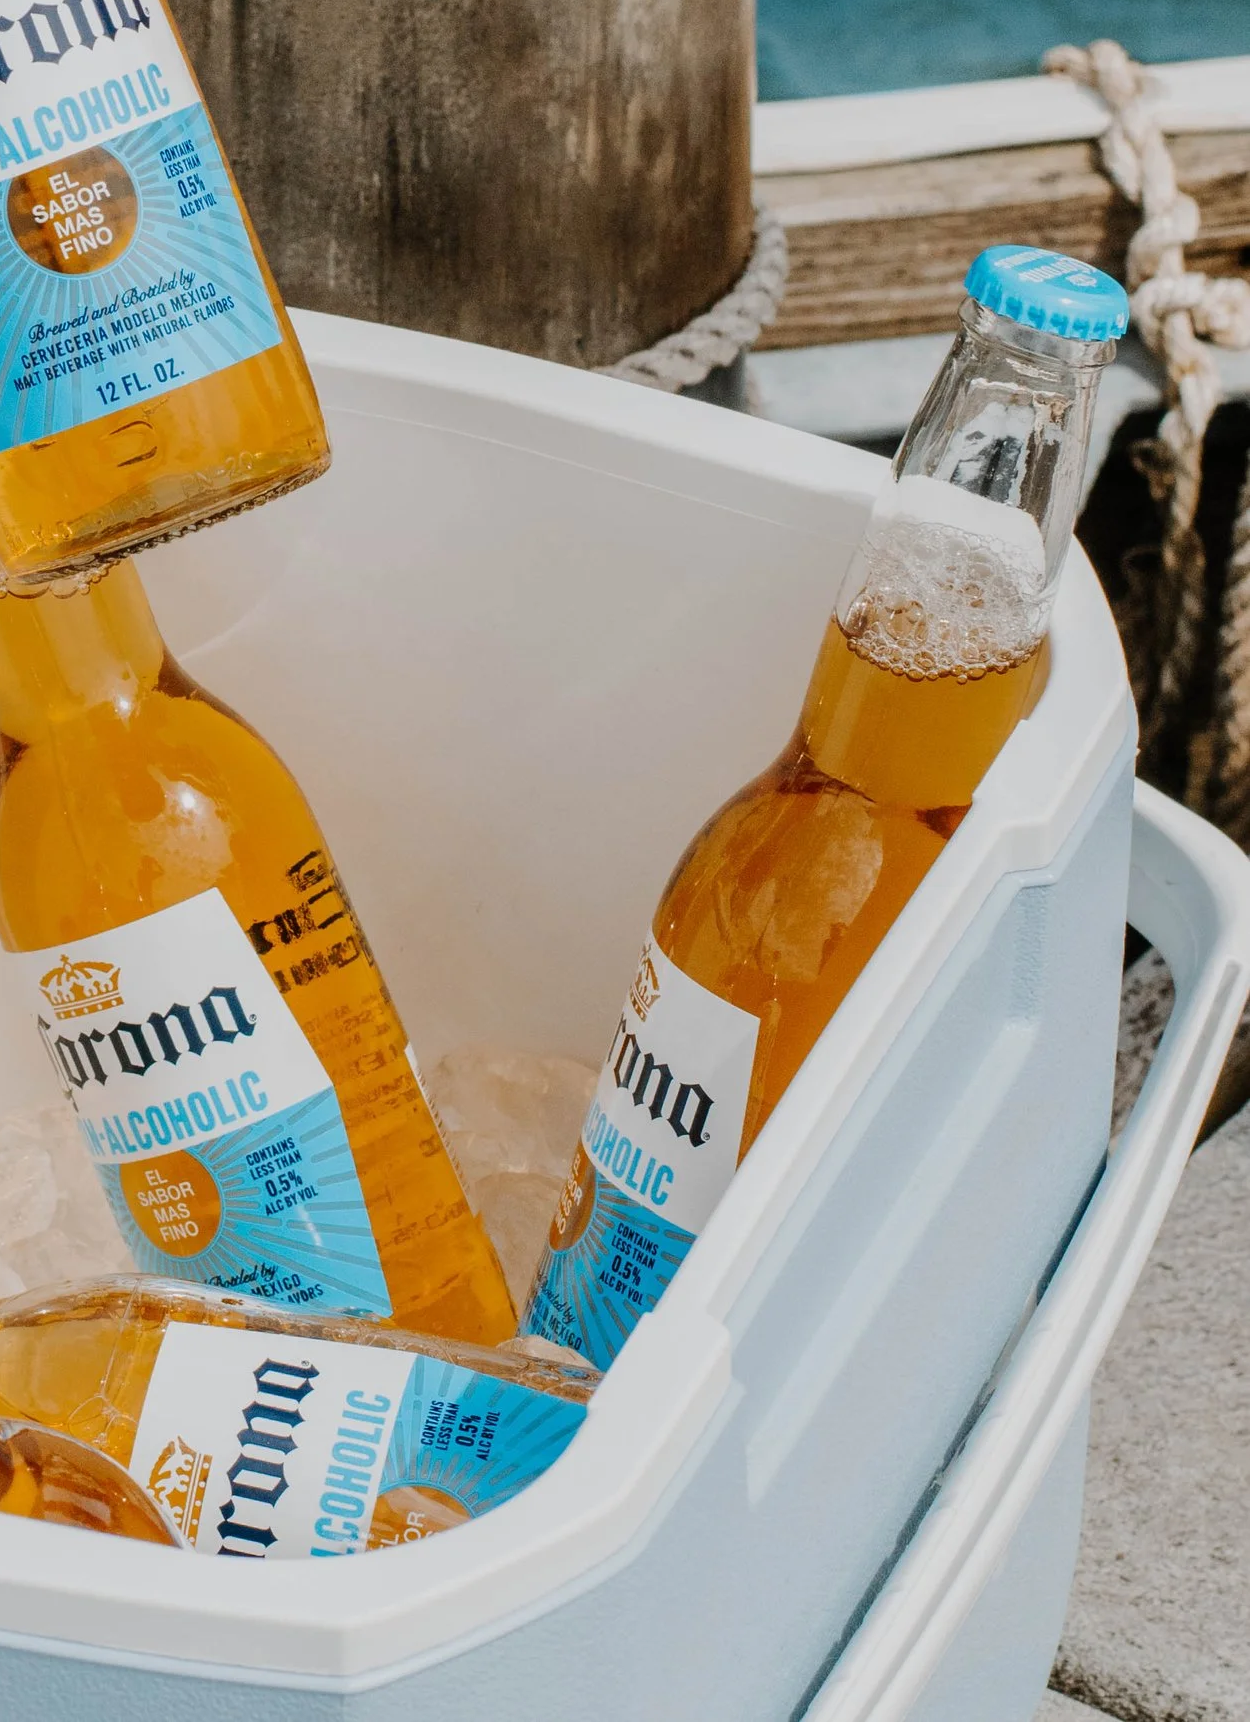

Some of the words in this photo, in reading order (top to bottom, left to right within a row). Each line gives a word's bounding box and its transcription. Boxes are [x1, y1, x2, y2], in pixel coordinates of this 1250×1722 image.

[160, 139, 195, 164] CONTAINS
[164, 161, 185, 180] LESS
[182, 154, 202, 172] THAN
[48, 171, 80, 194] EL
[177, 173, 206, 199] 0.5%
[32, 181, 111, 224] SABOR
[179, 202, 196, 219] ALC
[193, 197, 205, 212] BY
[203, 193, 217, 208] VOL
[53, 206, 105, 239] MAS
[59, 226, 113, 260] FINO
[28, 307, 89, 344] Brewed
[91, 294, 120, 320] and
[121, 275, 178, 309] Bottled
[178, 267, 196, 291] by
[20, 326, 109, 371] CERVECERIA
[111, 302, 168, 337] MODELO
[170, 282, 217, 314] MEXICO
[13, 370, 43, 393] MALT
[43, 346, 107, 382] BEVERAGE
[107, 334, 141, 358] WITH
[142, 316, 193, 345] NATURAL
[193, 295, 235, 324] FLAVORS
[95, 380, 121, 405] 12
[121, 371, 152, 397] FL.
[153, 358, 185, 383] OZ.
[37, 986, 257, 1113] orona
[607, 1012, 715, 1148] rona
[245, 1137, 296, 1167] CONTAINS
[249, 1161, 276, 1181] LESS
[276, 1149, 303, 1171] THAN
[144, 1168, 168, 1187] EL
[264, 1168, 303, 1198] 0.5%
[137, 1181, 195, 1208] SABOR
[264, 1197, 285, 1217] ALC
[284, 1190, 301, 1208] BY
[299, 1184, 319, 1203] VOL
[153, 1202, 191, 1224] MAS
[160, 1220, 199, 1244] FINO
[616, 1221, 659, 1256] CONTAINS
[610, 1234, 633, 1256] LESS
[632, 1246, 656, 1271] THAN
[260, 1261, 279, 1282] by
[611, 1256, 642, 1287] 0.5%
[599, 1269, 616, 1289] ALC
[614, 1278, 629, 1297] BY
[627, 1286, 644, 1306] VOL
[420, 1400, 445, 1446] CONTAINS
[441, 1402, 460, 1425] THAN
[484, 1411, 501, 1427] VOL
[434, 1426, 453, 1451] LESS
[455, 1414, 482, 1447] 0.5%
[480, 1427, 495, 1440] BY
[217, 1357, 320, 1559] rona
[475, 1439, 492, 1461] ALC
